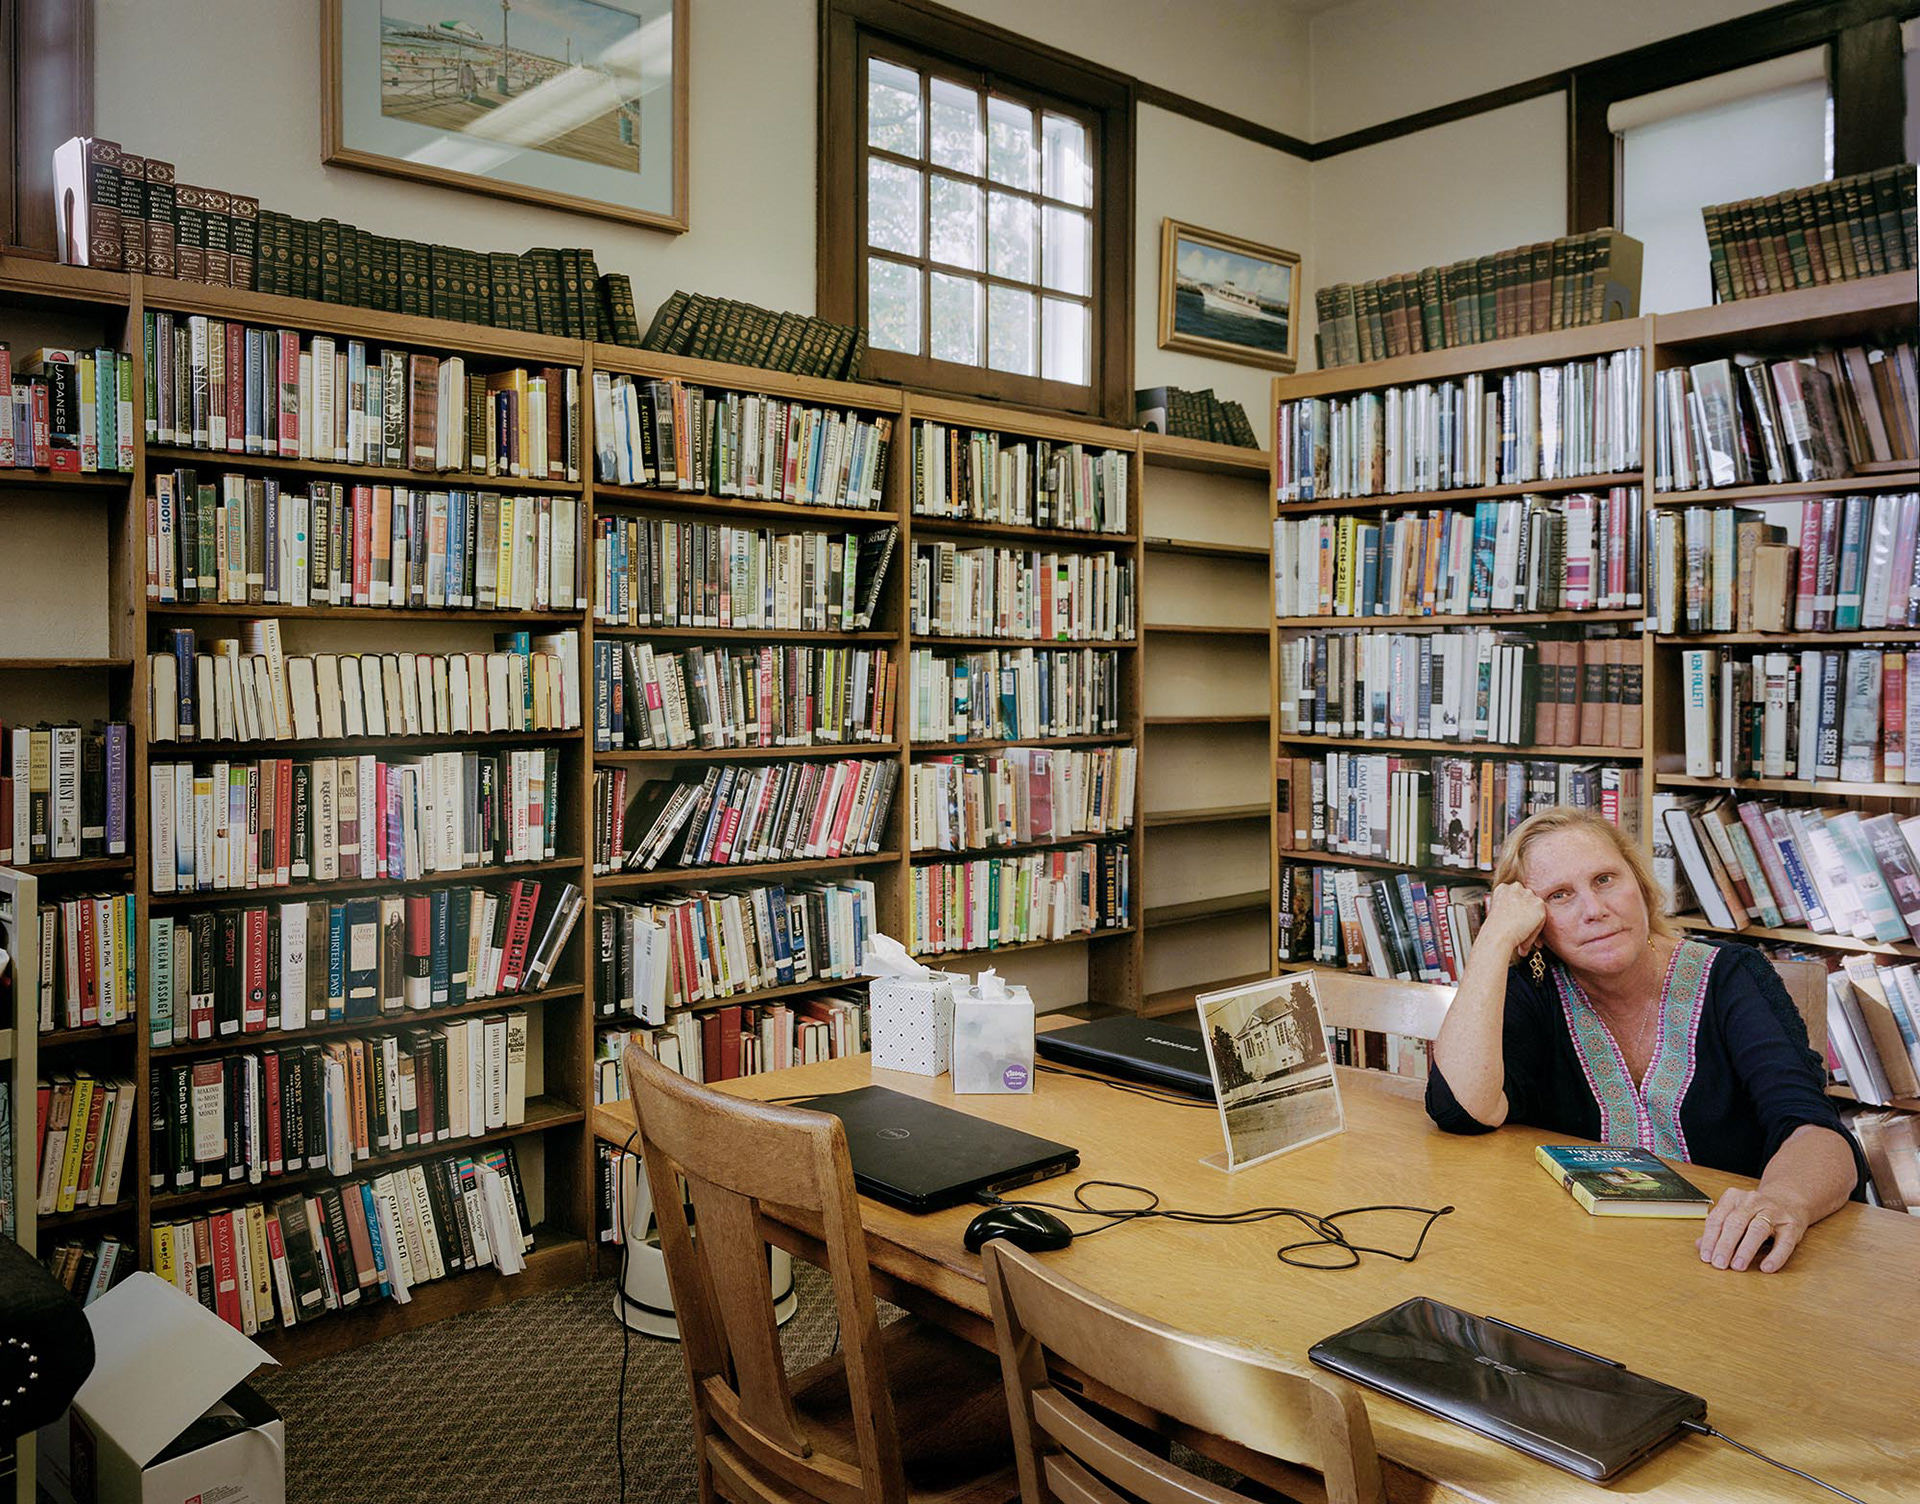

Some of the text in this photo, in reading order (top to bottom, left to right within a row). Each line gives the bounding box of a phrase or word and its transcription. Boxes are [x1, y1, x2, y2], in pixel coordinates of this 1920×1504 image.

[208, 324, 221, 379] SUNDAY
[55, 364, 66, 432] JAPANESE
[384, 374, 396, 446] SWORD
[694, 400, 702, 452] PRESIDENTS
[160, 494, 170, 534] IDIOT'S
[315, 507, 326, 584] CLASH TITANS
[1519, 521, 1527, 565] EGYPTIANS
[1801, 520, 1817, 581] RUSSIA
[869, 533, 896, 606] ORGANIZED CRIME
[620, 575, 628, 611] MISSOULA
[268, 624, 278, 653] HEARTS
[1692, 653, 1704, 708] KEN FOLLETT
[1857, 655, 1870, 696] VIETNAM
[599, 680, 607, 727] FATAL VISION
[1823, 656, 1838, 765] DANIEL ELLSBERG SECRETS
[60, 750, 74, 801] THE TRUST
[857, 767, 871, 805] PAPILLON
[297, 778, 307, 832] FINAL EXITS
[1313, 805, 1323, 815] BY
[1313, 815, 1323, 829] SEA
[1359, 765, 1368, 846] OMAHA BEACH
[1282, 879, 1290, 912] PACIFIC
[1322, 870, 1335, 908] D-DAY
[254, 911, 263, 946] LEGACY
[1377, 889, 1392, 932] FLYBOYS
[1417, 901, 1434, 956] TOM BROKAW
[104, 940, 110, 948] H.
[331, 926, 341, 997] THIRTEEN DAYS
[621, 945, 630, 975] BACK
[156, 924, 169, 1014] AMERICAN PASSAGE
[253, 958, 262, 987] ASHES
[1145, 1037, 1198, 1052] TOSHIBA
[376, 1057, 384, 1086] AGAINST
[77, 1082, 87, 1116] HEAVENS
[179, 1071, 188, 1124] You Can Do It!
[294, 1064, 304, 1154] MONEY POWER
[71, 1128, 80, 1153] EARTH
[416, 1186, 431, 1226] JUSTICE
[503, 1178, 512, 1202] Neighbor
[159, 1233, 170, 1270] Googled
